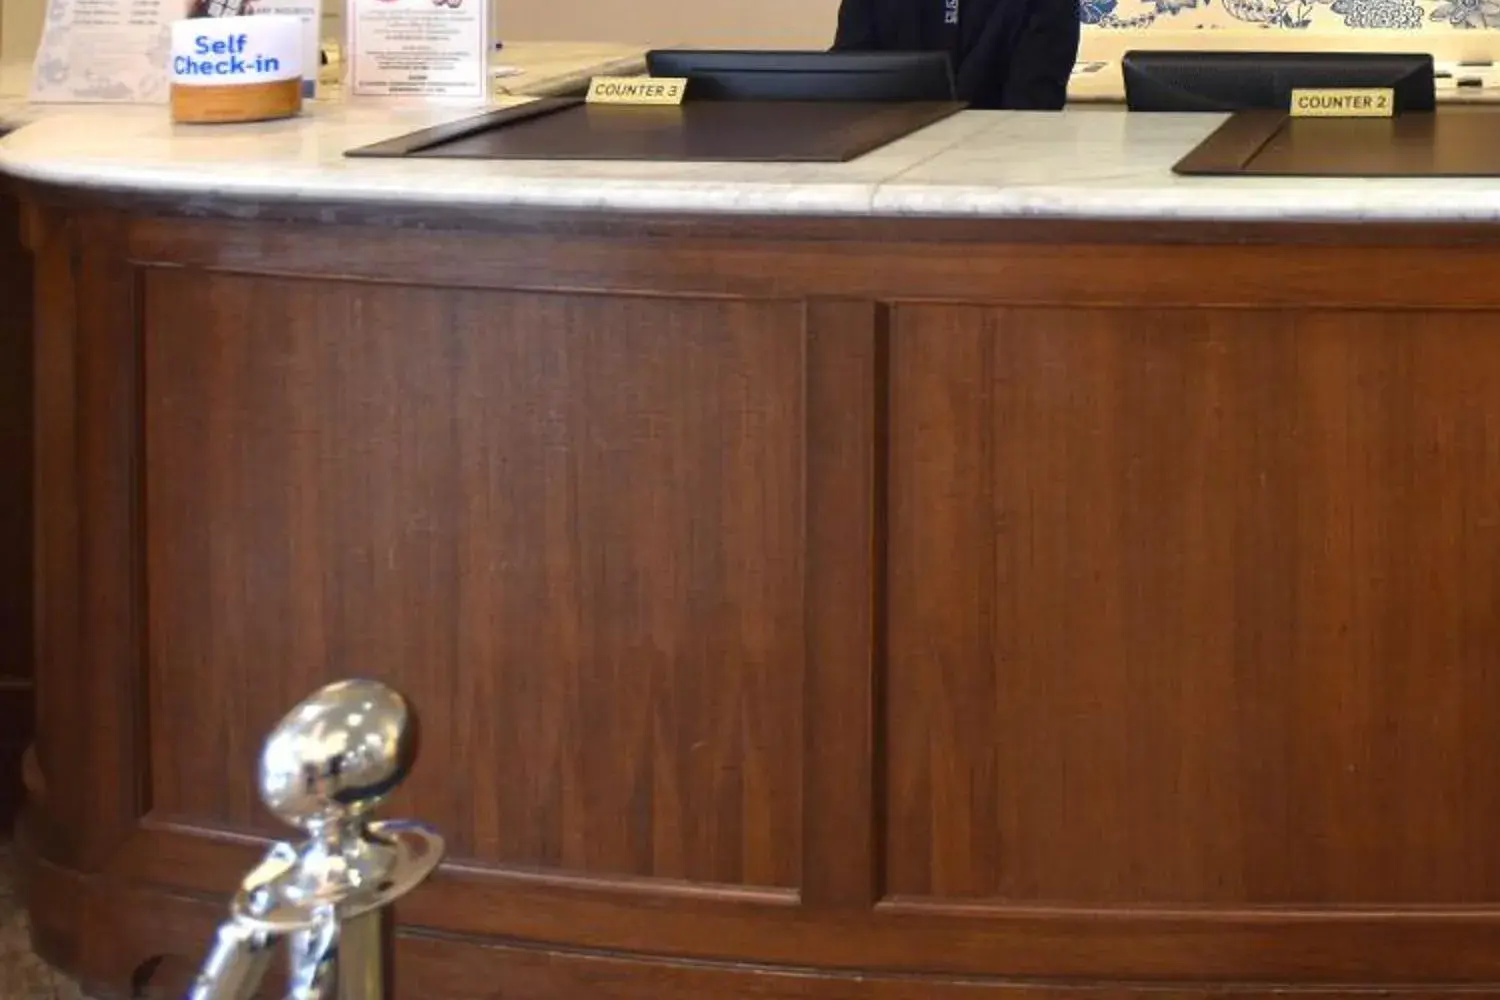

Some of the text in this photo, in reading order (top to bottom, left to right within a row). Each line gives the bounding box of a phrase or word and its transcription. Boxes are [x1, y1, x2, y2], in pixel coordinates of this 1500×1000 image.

[195, 34, 247, 55] Self
[174, 55, 280, 75] Check-in
[595, 83, 678, 97] COUNTER 3
[1298, 95, 1387, 109] COUNTER 2
